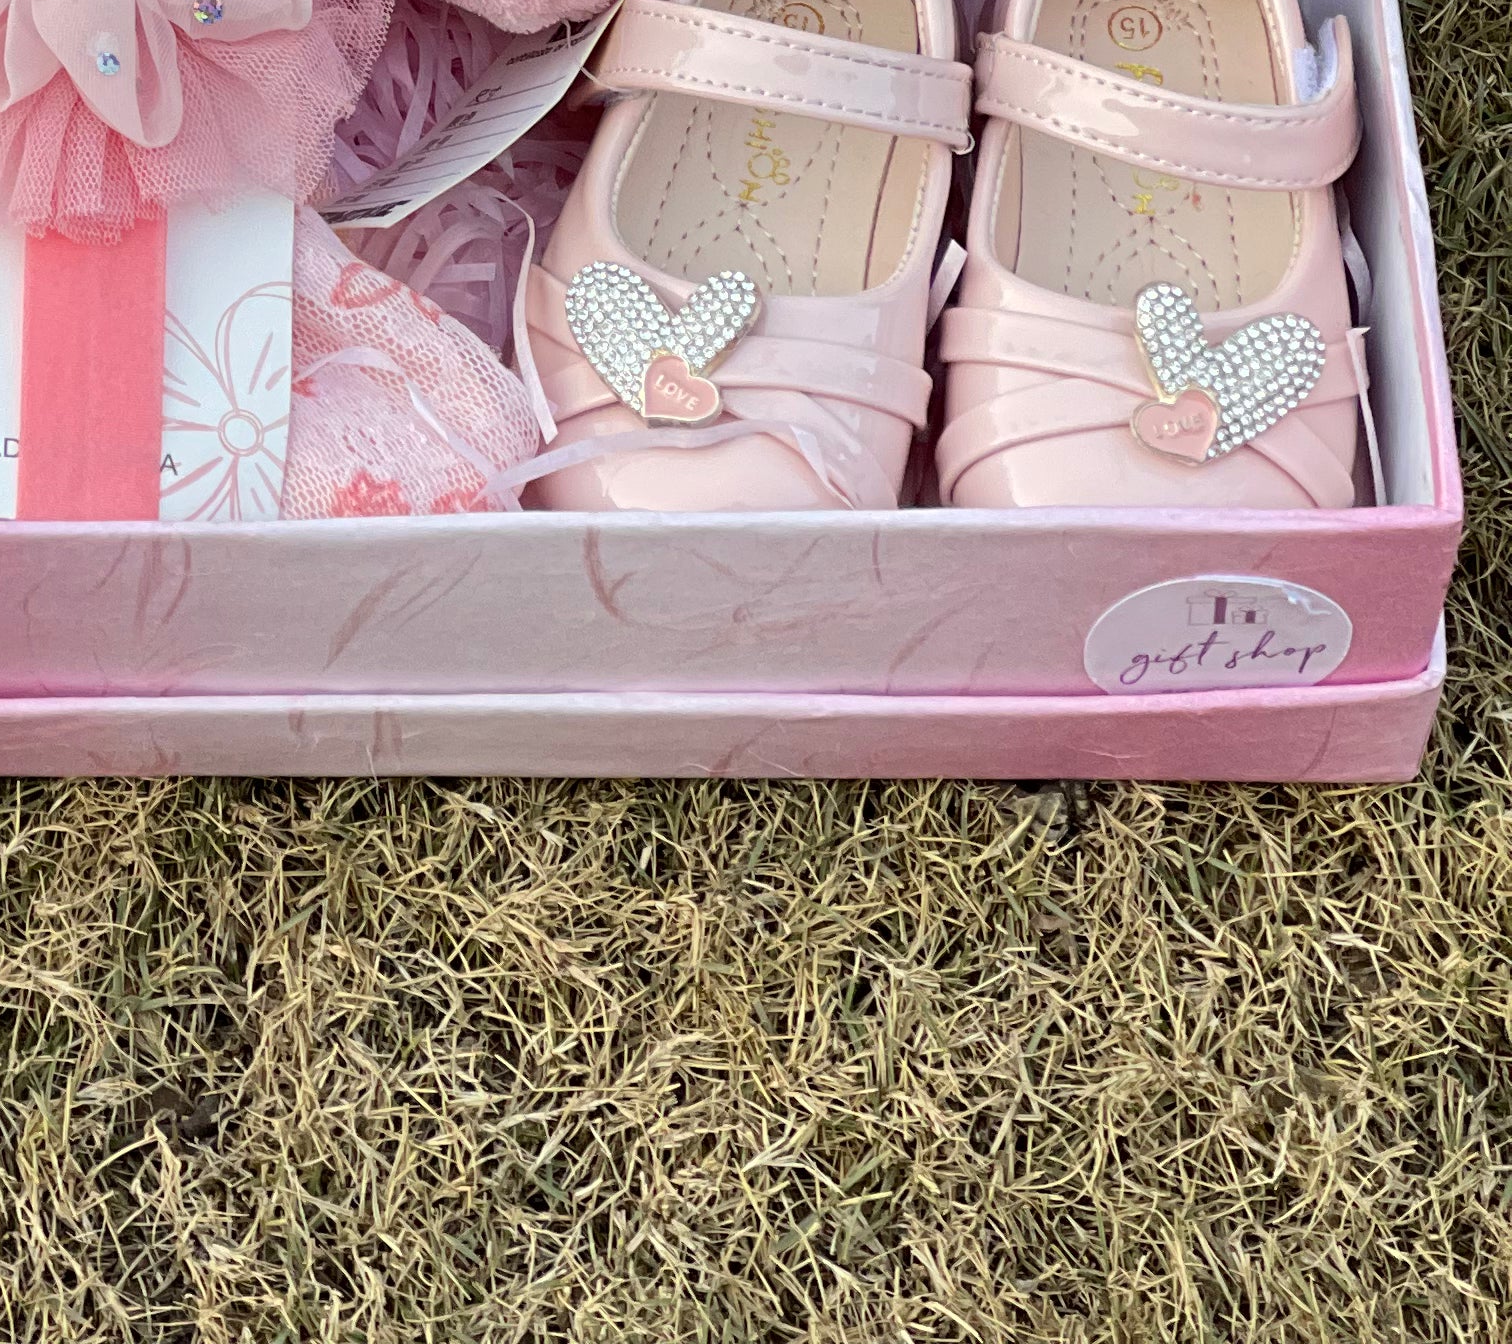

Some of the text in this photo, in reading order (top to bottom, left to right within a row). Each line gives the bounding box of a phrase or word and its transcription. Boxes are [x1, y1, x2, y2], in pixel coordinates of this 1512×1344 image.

[655, 374, 700, 411] LOVE
[1120, 630, 1327, 685] gift shop
